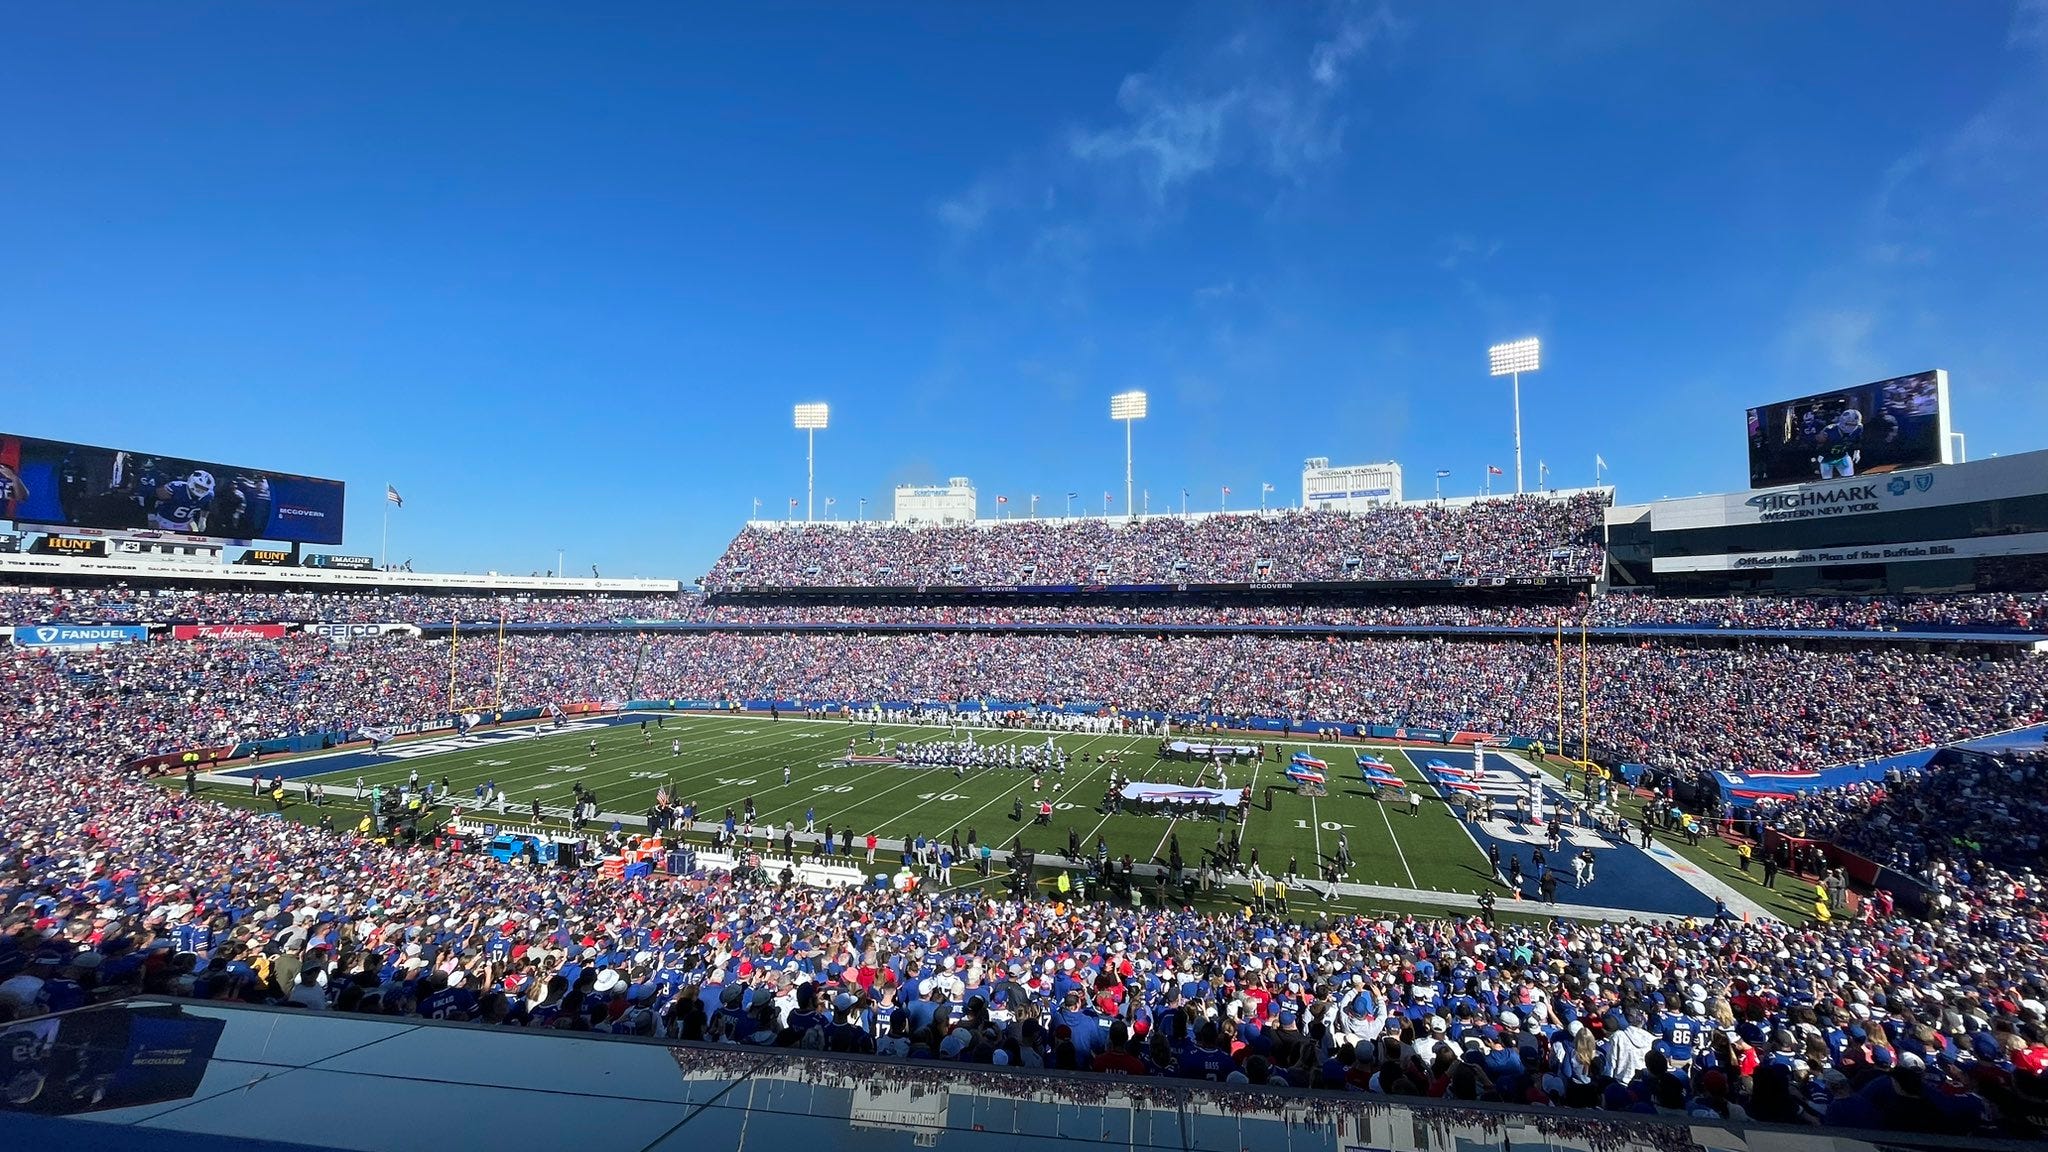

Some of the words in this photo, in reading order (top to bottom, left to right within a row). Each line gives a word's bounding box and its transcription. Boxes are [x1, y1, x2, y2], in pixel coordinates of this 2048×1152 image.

[1762, 485, 1878, 511] HIGHMARK
[280, 508, 324, 518] MCGOVERN
[1763, 508, 1815, 520] WESTERN
[1817, 505, 1844, 515] NEW
[1847, 502, 1879, 513] YORK
[48, 537, 96, 549] HUNT
[254, 551, 288, 560] HUNT
[331, 556, 370, 564] IMAGINE
[1738, 555, 1778, 567] Official
[1780, 553, 1816, 564] Health
[1819, 552, 1844, 562] Plan
[1846, 550, 1859, 560] of
[1861, 549, 1880, 559] the
[1883, 547, 1927, 558] Buffalo
[1929, 545, 1955, 555] Bills
[61, 630, 128, 639] FANDUEL
[198, 627, 219, 639] Tim
[220, 626, 264, 639] Hortons
[315, 625, 380, 636] GEICO
[421, 719, 454, 732] BILLS
[812, 784, 854, 793] 50
[1293, 819, 1342, 831] 10
[492, 950, 503, 962] 17
[874, 1023, 891, 1039] 17
[1672, 1030, 1691, 1044] 86
